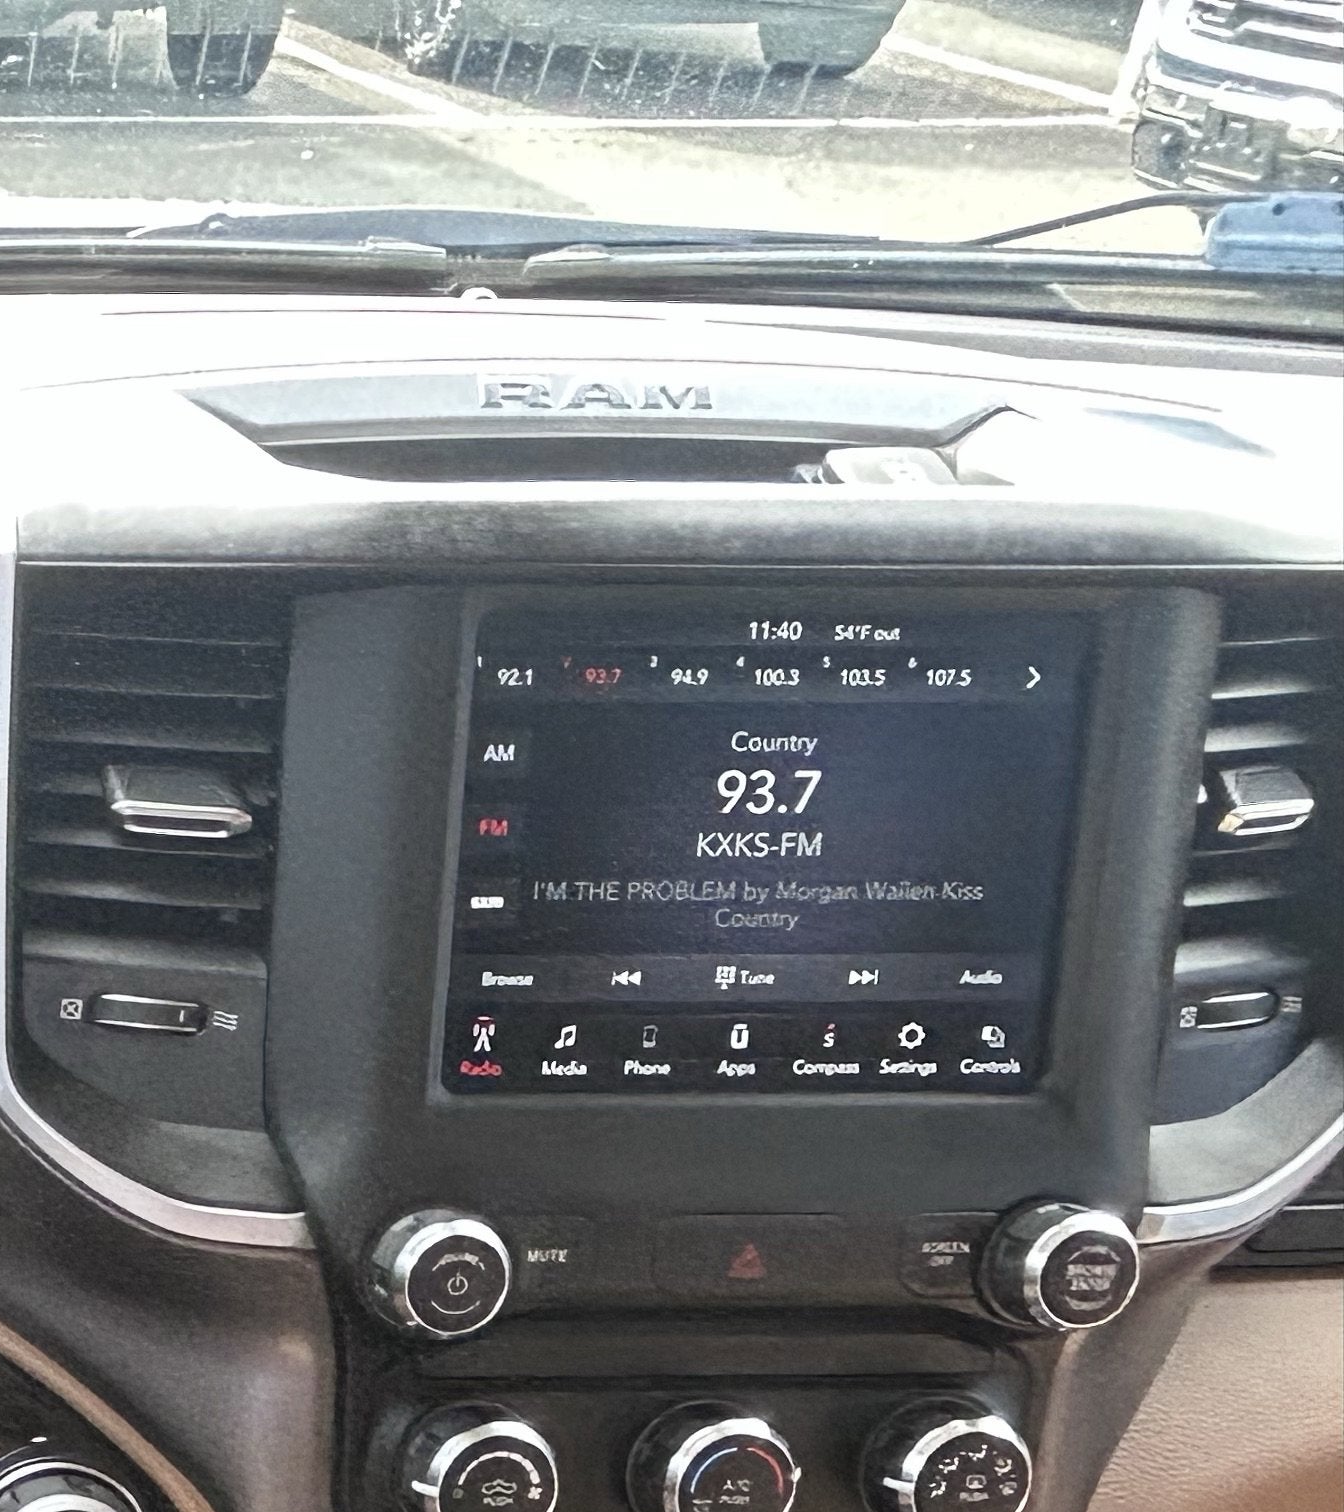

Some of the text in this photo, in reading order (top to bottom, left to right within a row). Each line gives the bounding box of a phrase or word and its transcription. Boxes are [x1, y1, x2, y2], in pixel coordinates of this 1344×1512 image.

[481, 383, 713, 410] RAM
[749, 621, 803, 640] 11:40
[497, 668, 533, 686] 92.1
[584, 667, 622, 685] 93.7
[755, 668, 800, 686] 100.3
[926, 668, 972, 687] 107.5
[483, 744, 515, 762] AM
[731, 731, 818, 757] Country
[716, 769, 823, 815] 93.7
[479, 819, 508, 836] FM
[696, 832, 823, 858] KXKS-FM
[533, 880, 567, 901] I'M
[574, 881, 621, 901] THE
[627, 880, 736, 901] PROBLEM
[743, 881, 769, 905] by
[775, 881, 859, 905] Morgan
[715, 908, 800, 931] Country
[481, 971, 533, 987] Browse
[740, 970, 775, 985] Tune
[959, 969, 1003, 984] Audio
[460, 1059, 502, 1077] Radio
[541, 1060, 588, 1076] Media
[623, 1060, 671, 1076] Phone
[716, 1060, 756, 1077] Apps
[792, 1059, 860, 1076] Compass
[879, 1058, 938, 1077] Settings
[960, 1058, 1021, 1074] Controls
[527, 1249, 568, 1263] MUTE
